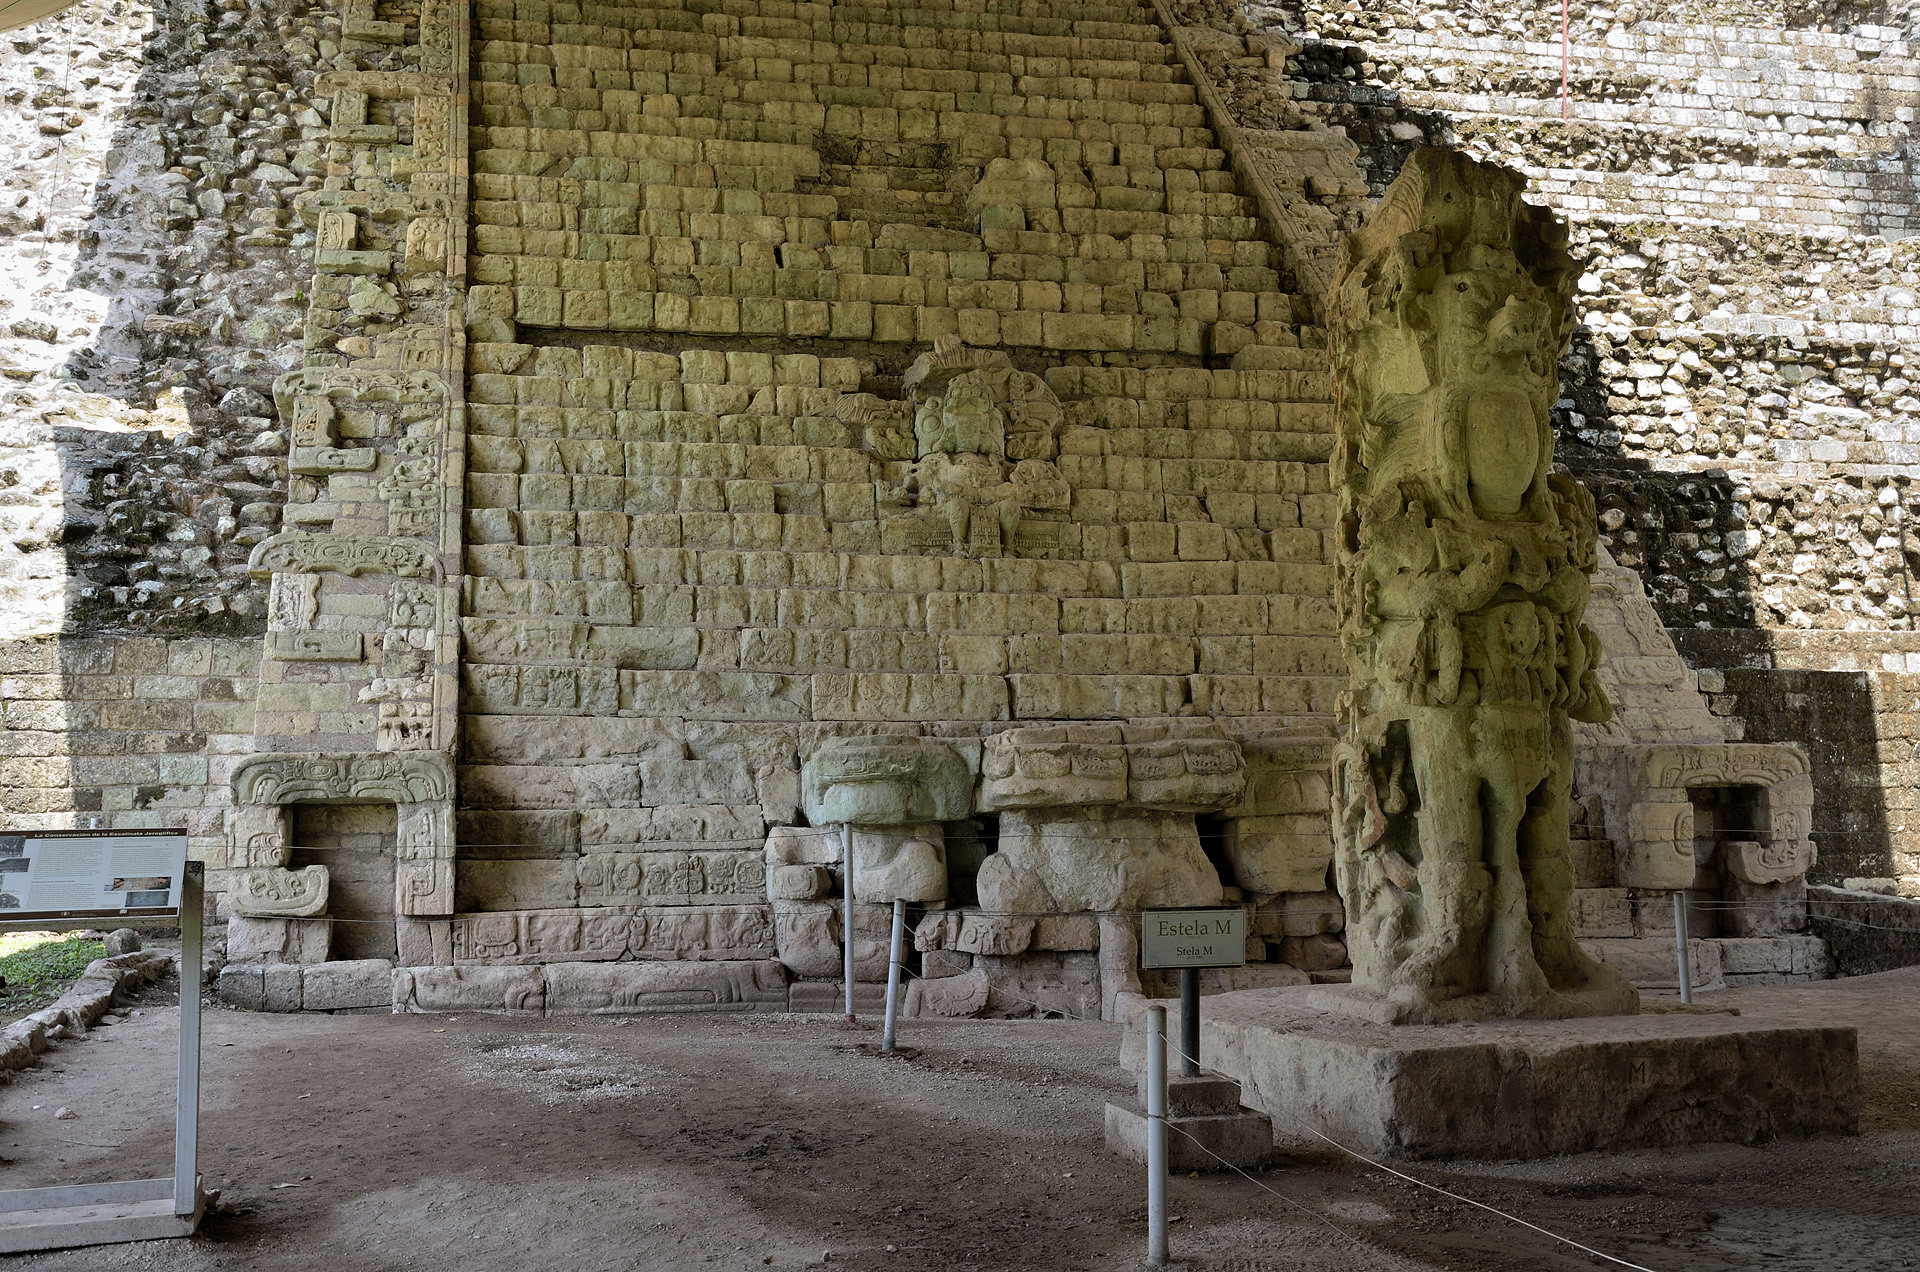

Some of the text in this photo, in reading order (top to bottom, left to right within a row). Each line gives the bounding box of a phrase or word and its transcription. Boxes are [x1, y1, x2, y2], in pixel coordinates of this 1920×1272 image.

[1158, 919, 1231, 936] Estela M
[1176, 946, 1213, 956] Stela M
[1629, 1061, 1646, 1085] M
